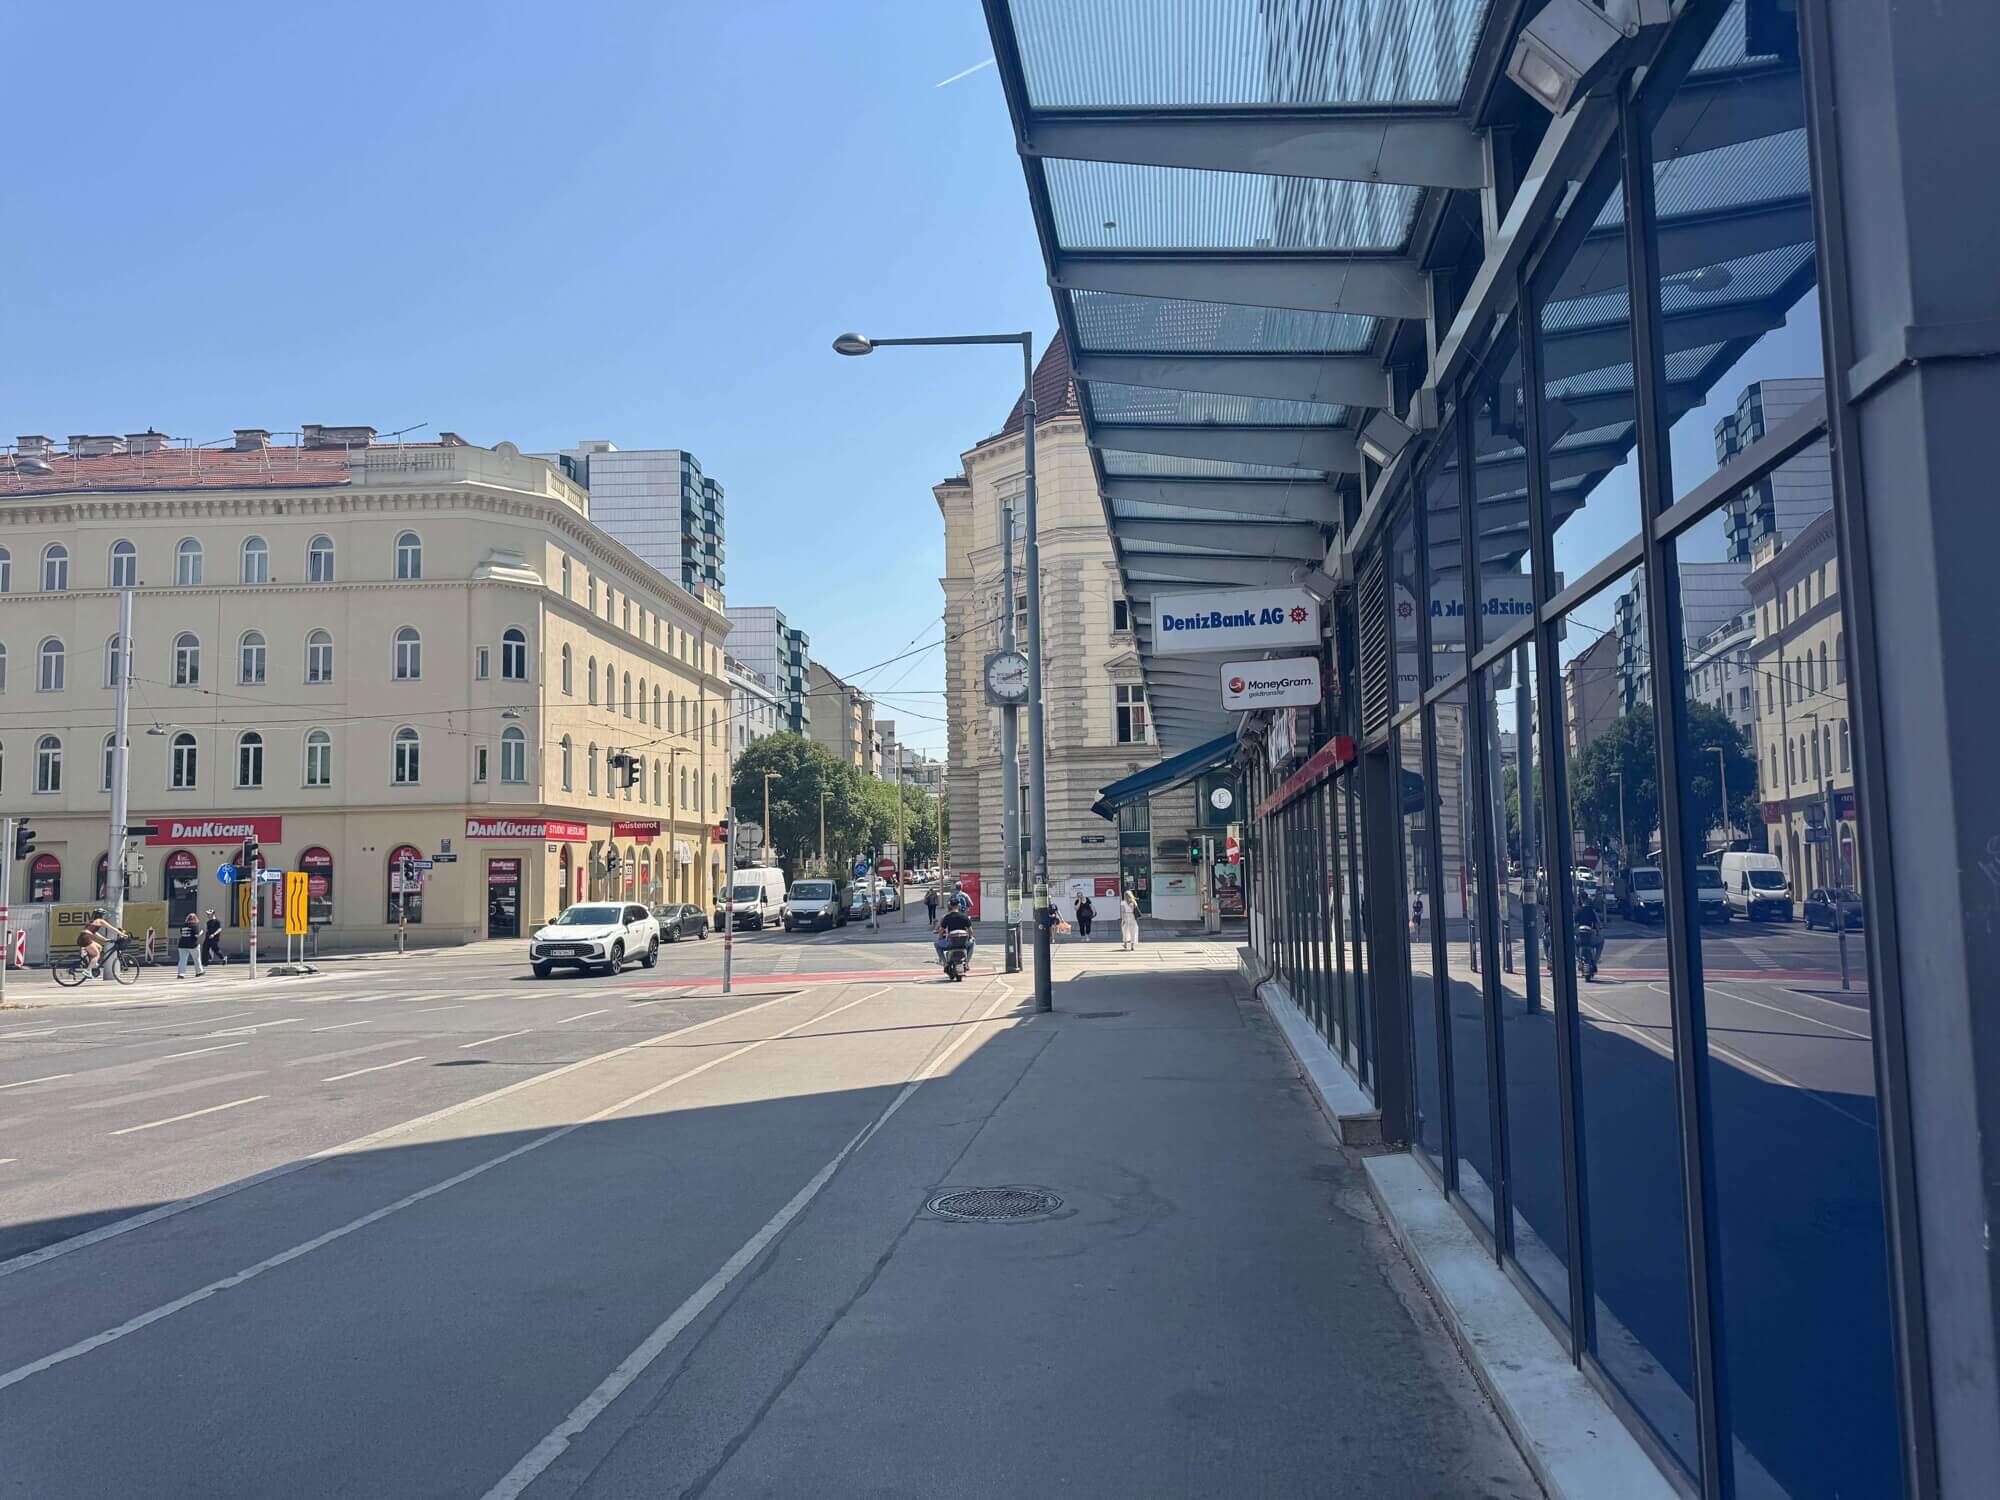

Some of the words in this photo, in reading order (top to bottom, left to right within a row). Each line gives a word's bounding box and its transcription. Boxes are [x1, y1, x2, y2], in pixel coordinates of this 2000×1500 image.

[1162, 609, 1256, 632] DenizBank
[1259, 607, 1284, 625] AG
[618, 821, 657, 829] wüstenrot
